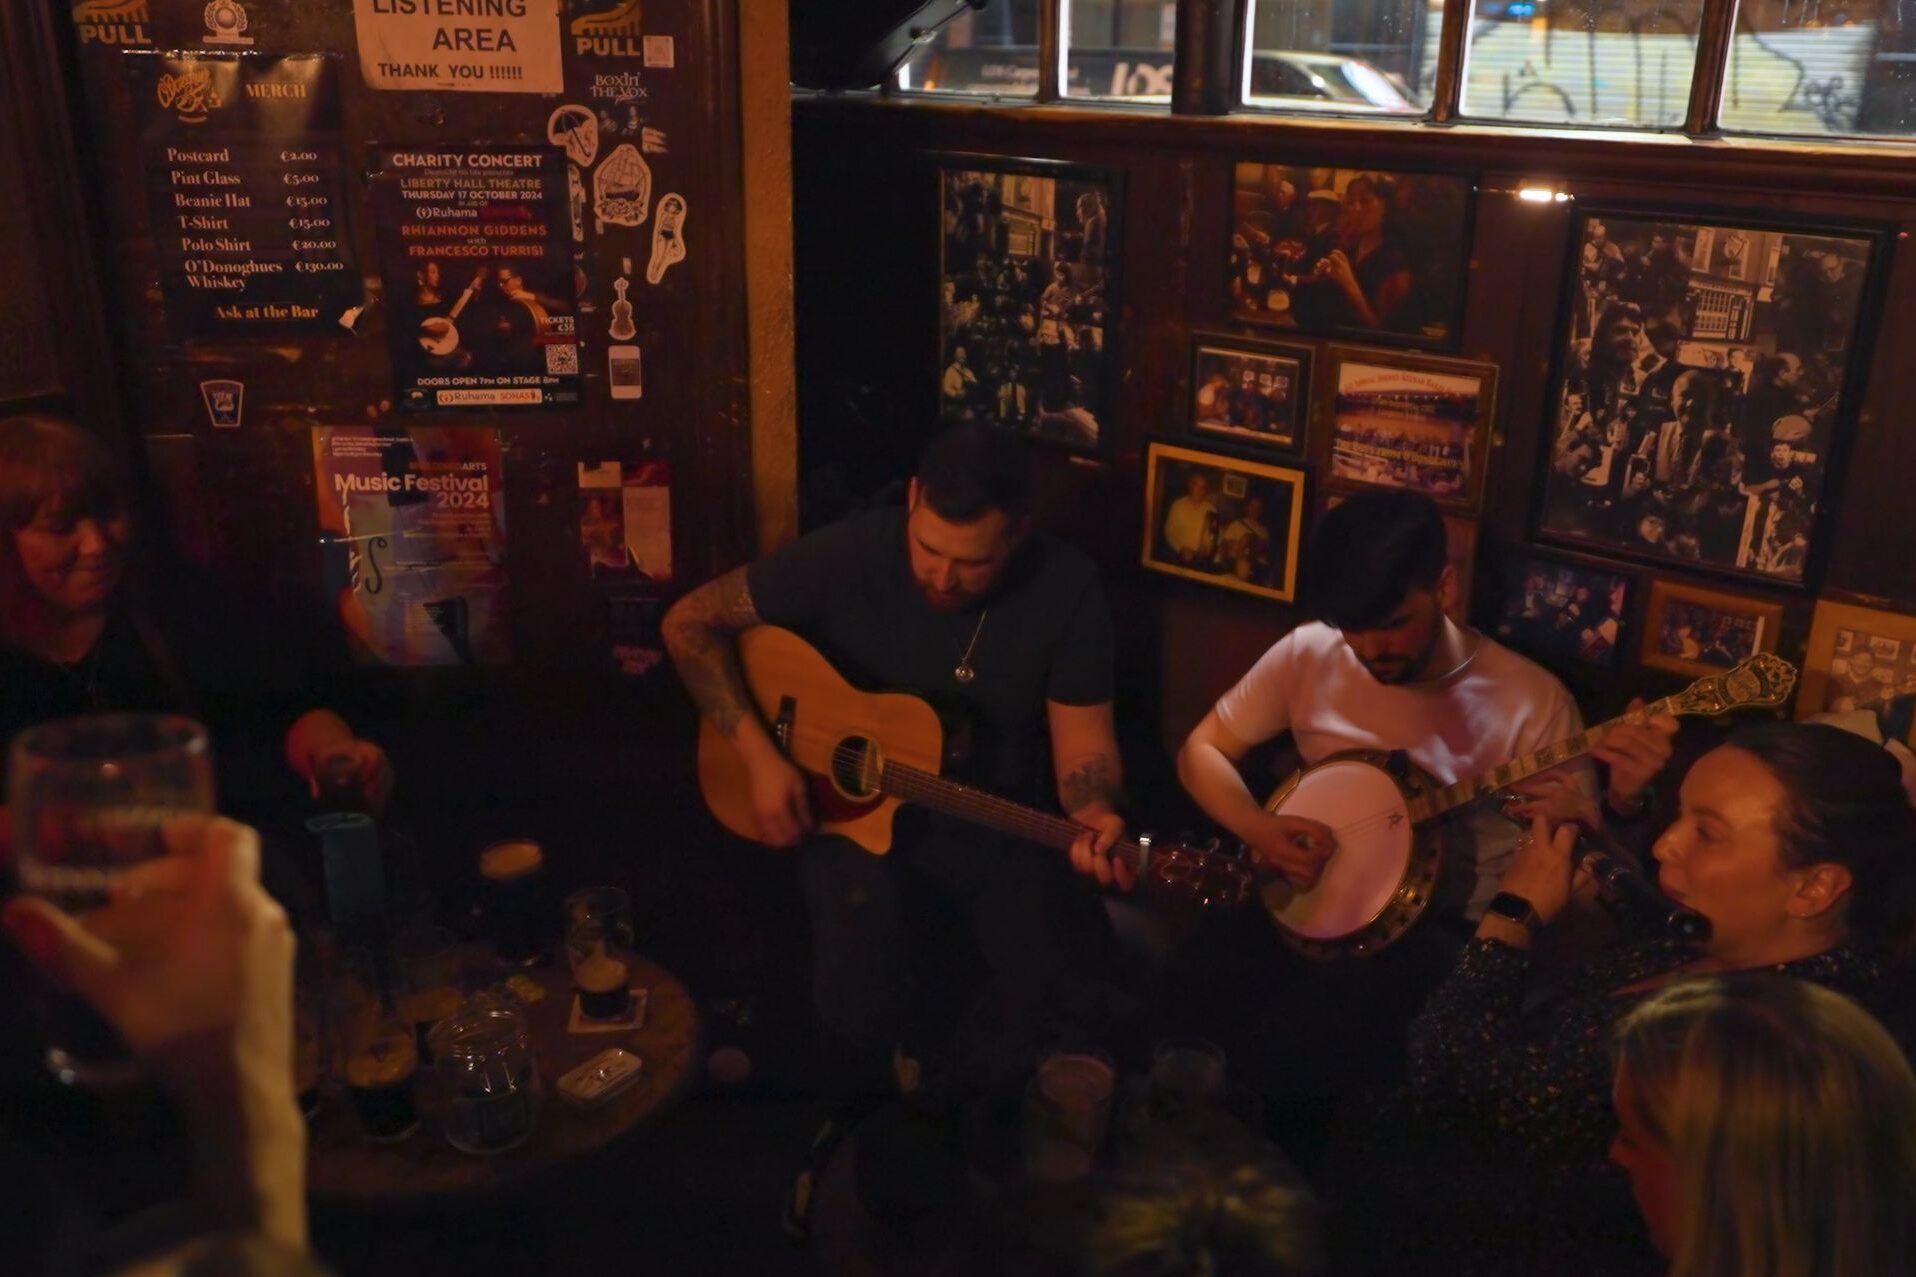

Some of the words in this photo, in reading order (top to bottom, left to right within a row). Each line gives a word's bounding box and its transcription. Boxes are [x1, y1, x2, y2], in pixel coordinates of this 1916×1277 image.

[373, 0, 527, 17] LISTENING
[79, 24, 151, 45] PULL
[432, 27, 517, 52] AREA
[576, 37, 640, 56] PULL
[377, 63, 439, 78] THANK
[448, 64, 484, 79] YOU
[245, 83, 307, 98] MERCH
[168, 148, 230, 163] Postcard
[280, 151, 318, 162] €2.00
[392, 153, 464, 168] CHARITY
[467, 154, 543, 168] CONCERT
[170, 170, 200, 185] Pint
[203, 170, 241, 185] Glass
[283, 174, 319, 185] €5.00
[400, 178, 451, 190] LIBERTY
[453, 178, 486, 190] HALL
[489, 178, 542, 190] THEATRE
[175, 193, 223, 207] Beanie
[225, 193, 251, 208] Hat
[286, 195, 328, 208] €15.00
[401, 190, 455, 200] THURSDAY
[457, 190, 468, 200] 17
[469, 190, 518, 200] OCTOBER
[520, 190, 542, 200] 2024
[432, 207, 478, 218] Ruhama
[177, 216, 229, 230] T-Shirt
[289, 217, 331, 230] €15.00
[401, 224, 480, 237] RHIANNON
[483, 224, 547, 237] GIDDENS
[182, 237, 214, 252] Polo
[215, 238, 251, 252] Shirt
[292, 239, 337, 251] €20.00
[408, 244, 489, 257] FRANCESCO
[492, 244, 544, 257] TURRISI
[295, 260, 344, 273] €130.00
[187, 275, 247, 293] Whiskey
[214, 305, 243, 320] Ask
[245, 308, 260, 319] at
[262, 305, 288, 319] the
[290, 305, 319, 319] Bar
[416, 376, 450, 386] DOORS
[451, 376, 478, 386] OPEN
[496, 376, 512, 385] ON
[512, 376, 541, 385] STAGE
[454, 390, 496, 401] Ruhama
[462, 462, 487, 471] ARTS
[333, 472, 402, 492] Music
[404, 473, 489, 492] Festival
[436, 492, 490, 509] 2024
